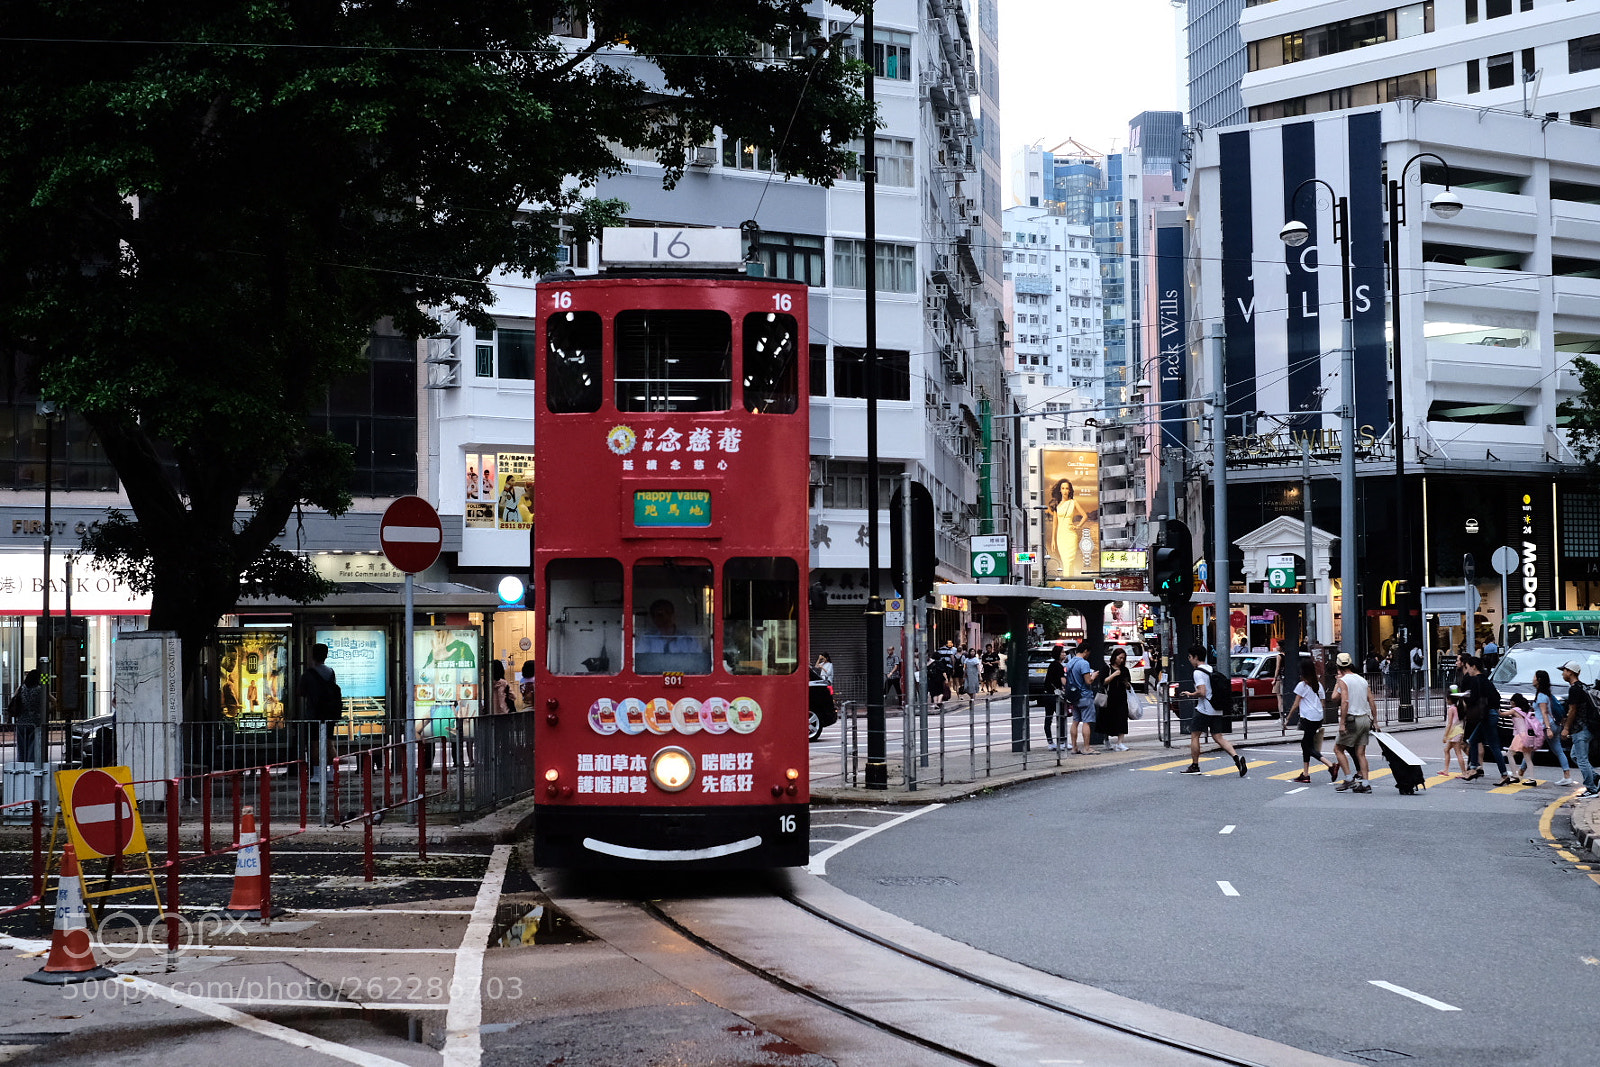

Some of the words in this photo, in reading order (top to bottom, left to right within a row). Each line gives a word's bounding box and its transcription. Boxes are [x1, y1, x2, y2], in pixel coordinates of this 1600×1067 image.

[653, 231, 690, 259] 16
[551, 291, 572, 309] 16
[772, 293, 792, 311] 16
[1160, 289, 1179, 339] Wills
[642, 428, 655, 452] 京都
[637, 491, 672, 503] Happy
[677, 491, 710, 503] Valley
[645, 503, 704, 517] 跑馬地
[1522, 526, 1532, 534] 24
[32, 578, 89, 593] BANK
[664, 676, 683, 685] S01
[577, 775, 648, 793] 護喉潤聲
[702, 774, 754, 793] 先係好
[779, 815, 796, 833] 16
